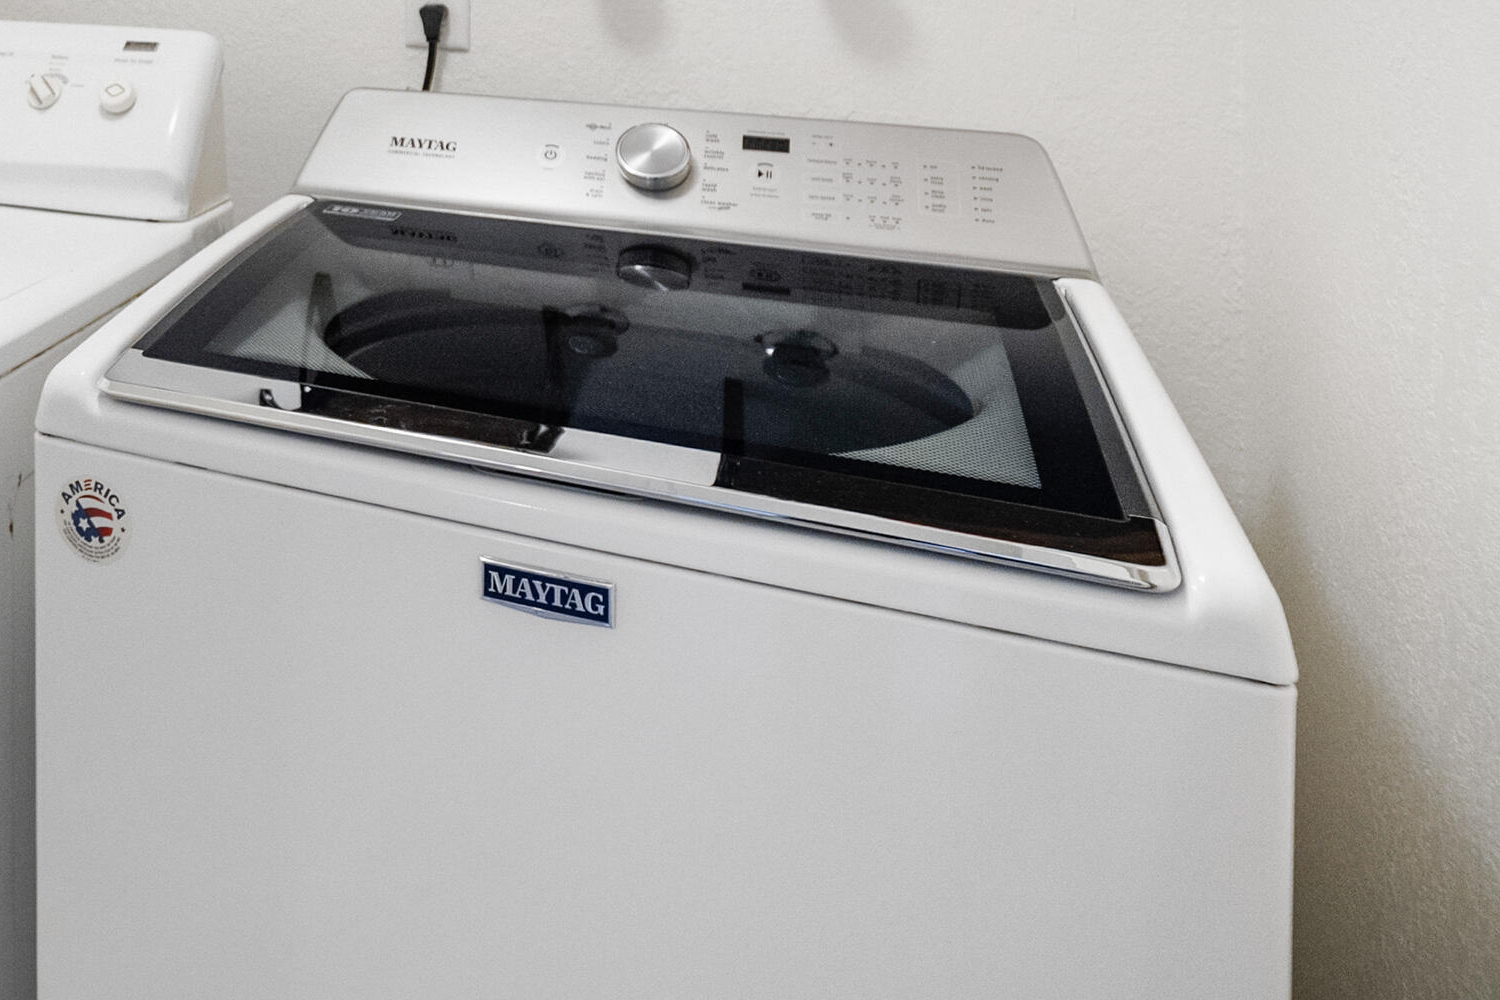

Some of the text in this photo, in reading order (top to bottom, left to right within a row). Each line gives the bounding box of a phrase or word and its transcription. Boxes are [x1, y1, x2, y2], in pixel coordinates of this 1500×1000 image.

[389, 136, 457, 152] MAYTAG
[61, 479, 126, 520] AMERICA
[488, 570, 605, 616] MAYTAG
